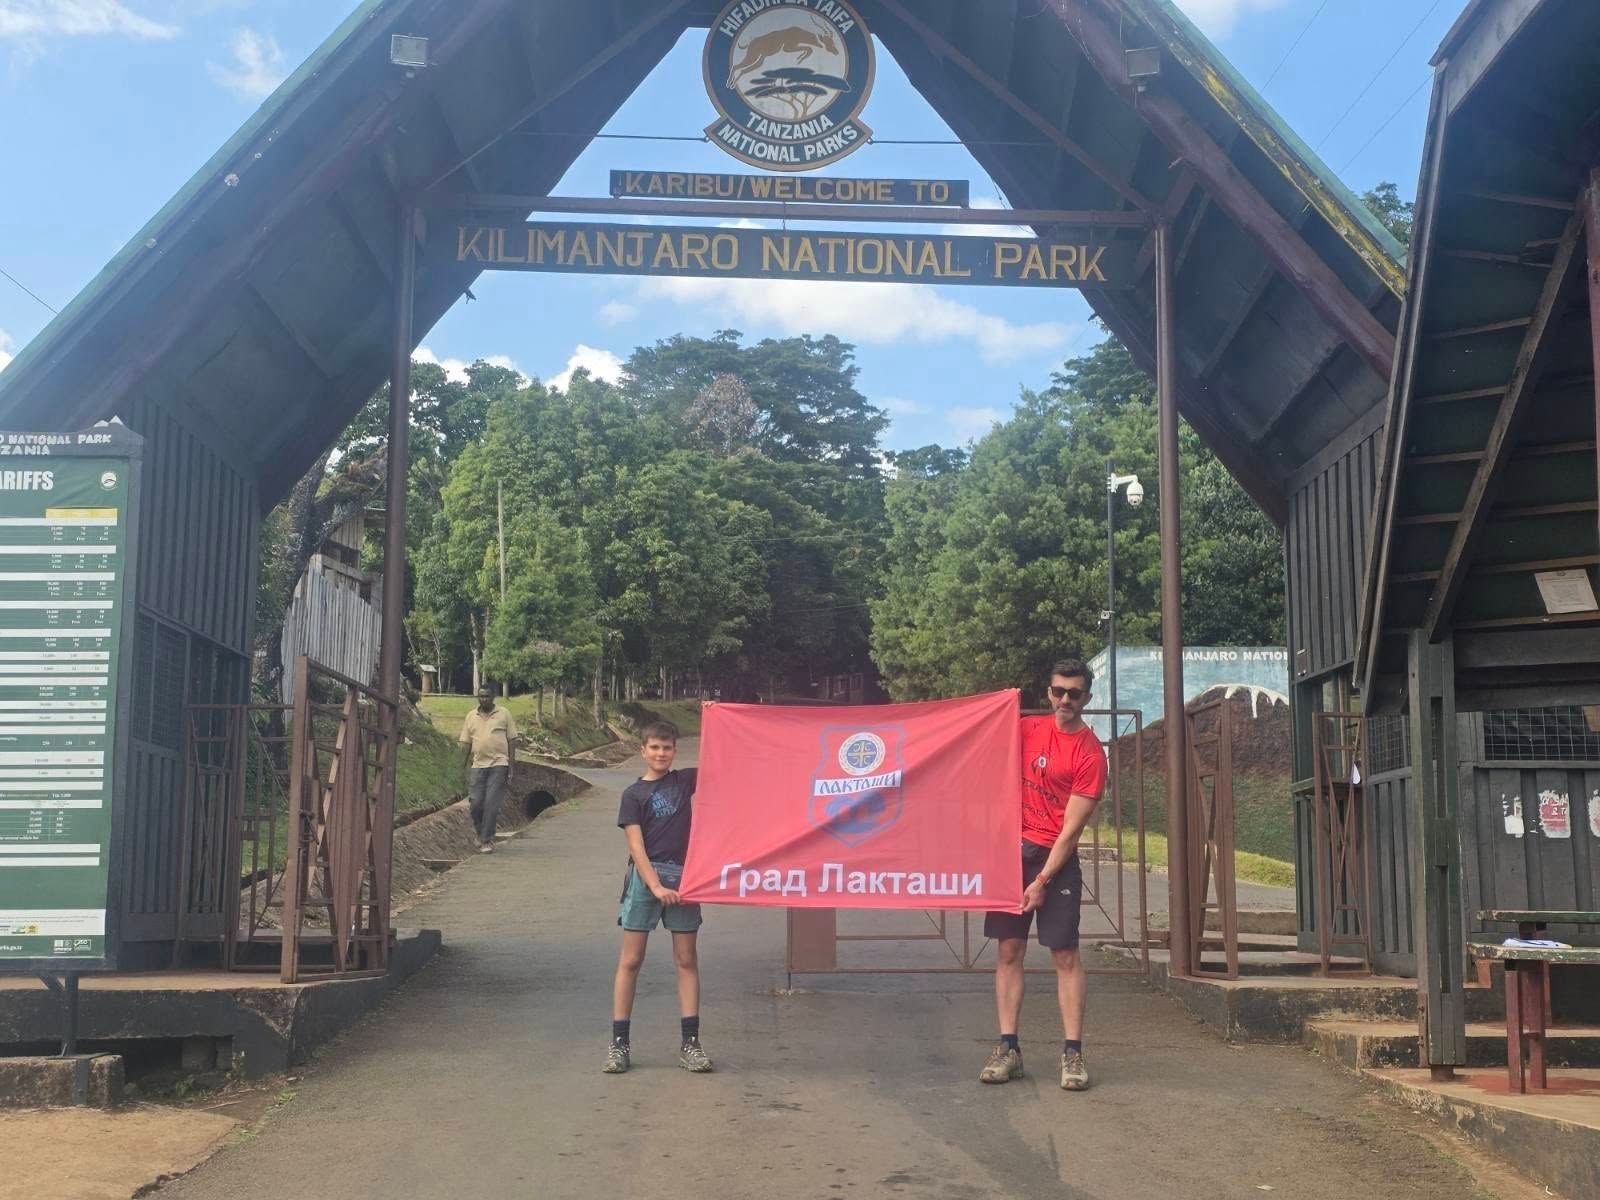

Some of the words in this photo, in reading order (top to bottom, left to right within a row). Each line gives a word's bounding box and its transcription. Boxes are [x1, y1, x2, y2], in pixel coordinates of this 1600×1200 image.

[746, 111, 834, 140] TANZANIA
[717, 123, 800, 163] NATIONAL
[804, 125, 858, 161] PARKS
[624, 172, 896, 202] KARIBU/WELCOME
[910, 180, 949, 203] TO
[456, 226, 739, 270] KILIMANJARO
[760, 235, 972, 277] NATIONAL
[993, 241, 1108, 282] PARK
[8, 434, 71, 445] NATIONAL
[77, 434, 112, 444] PARK
[1149, 650, 1237, 661] KIANJARO
[819, 772, 897, 795] ЛАКТАШИ
[719, 863, 807, 898] Град
[818, 863, 982, 896] Лакташи
